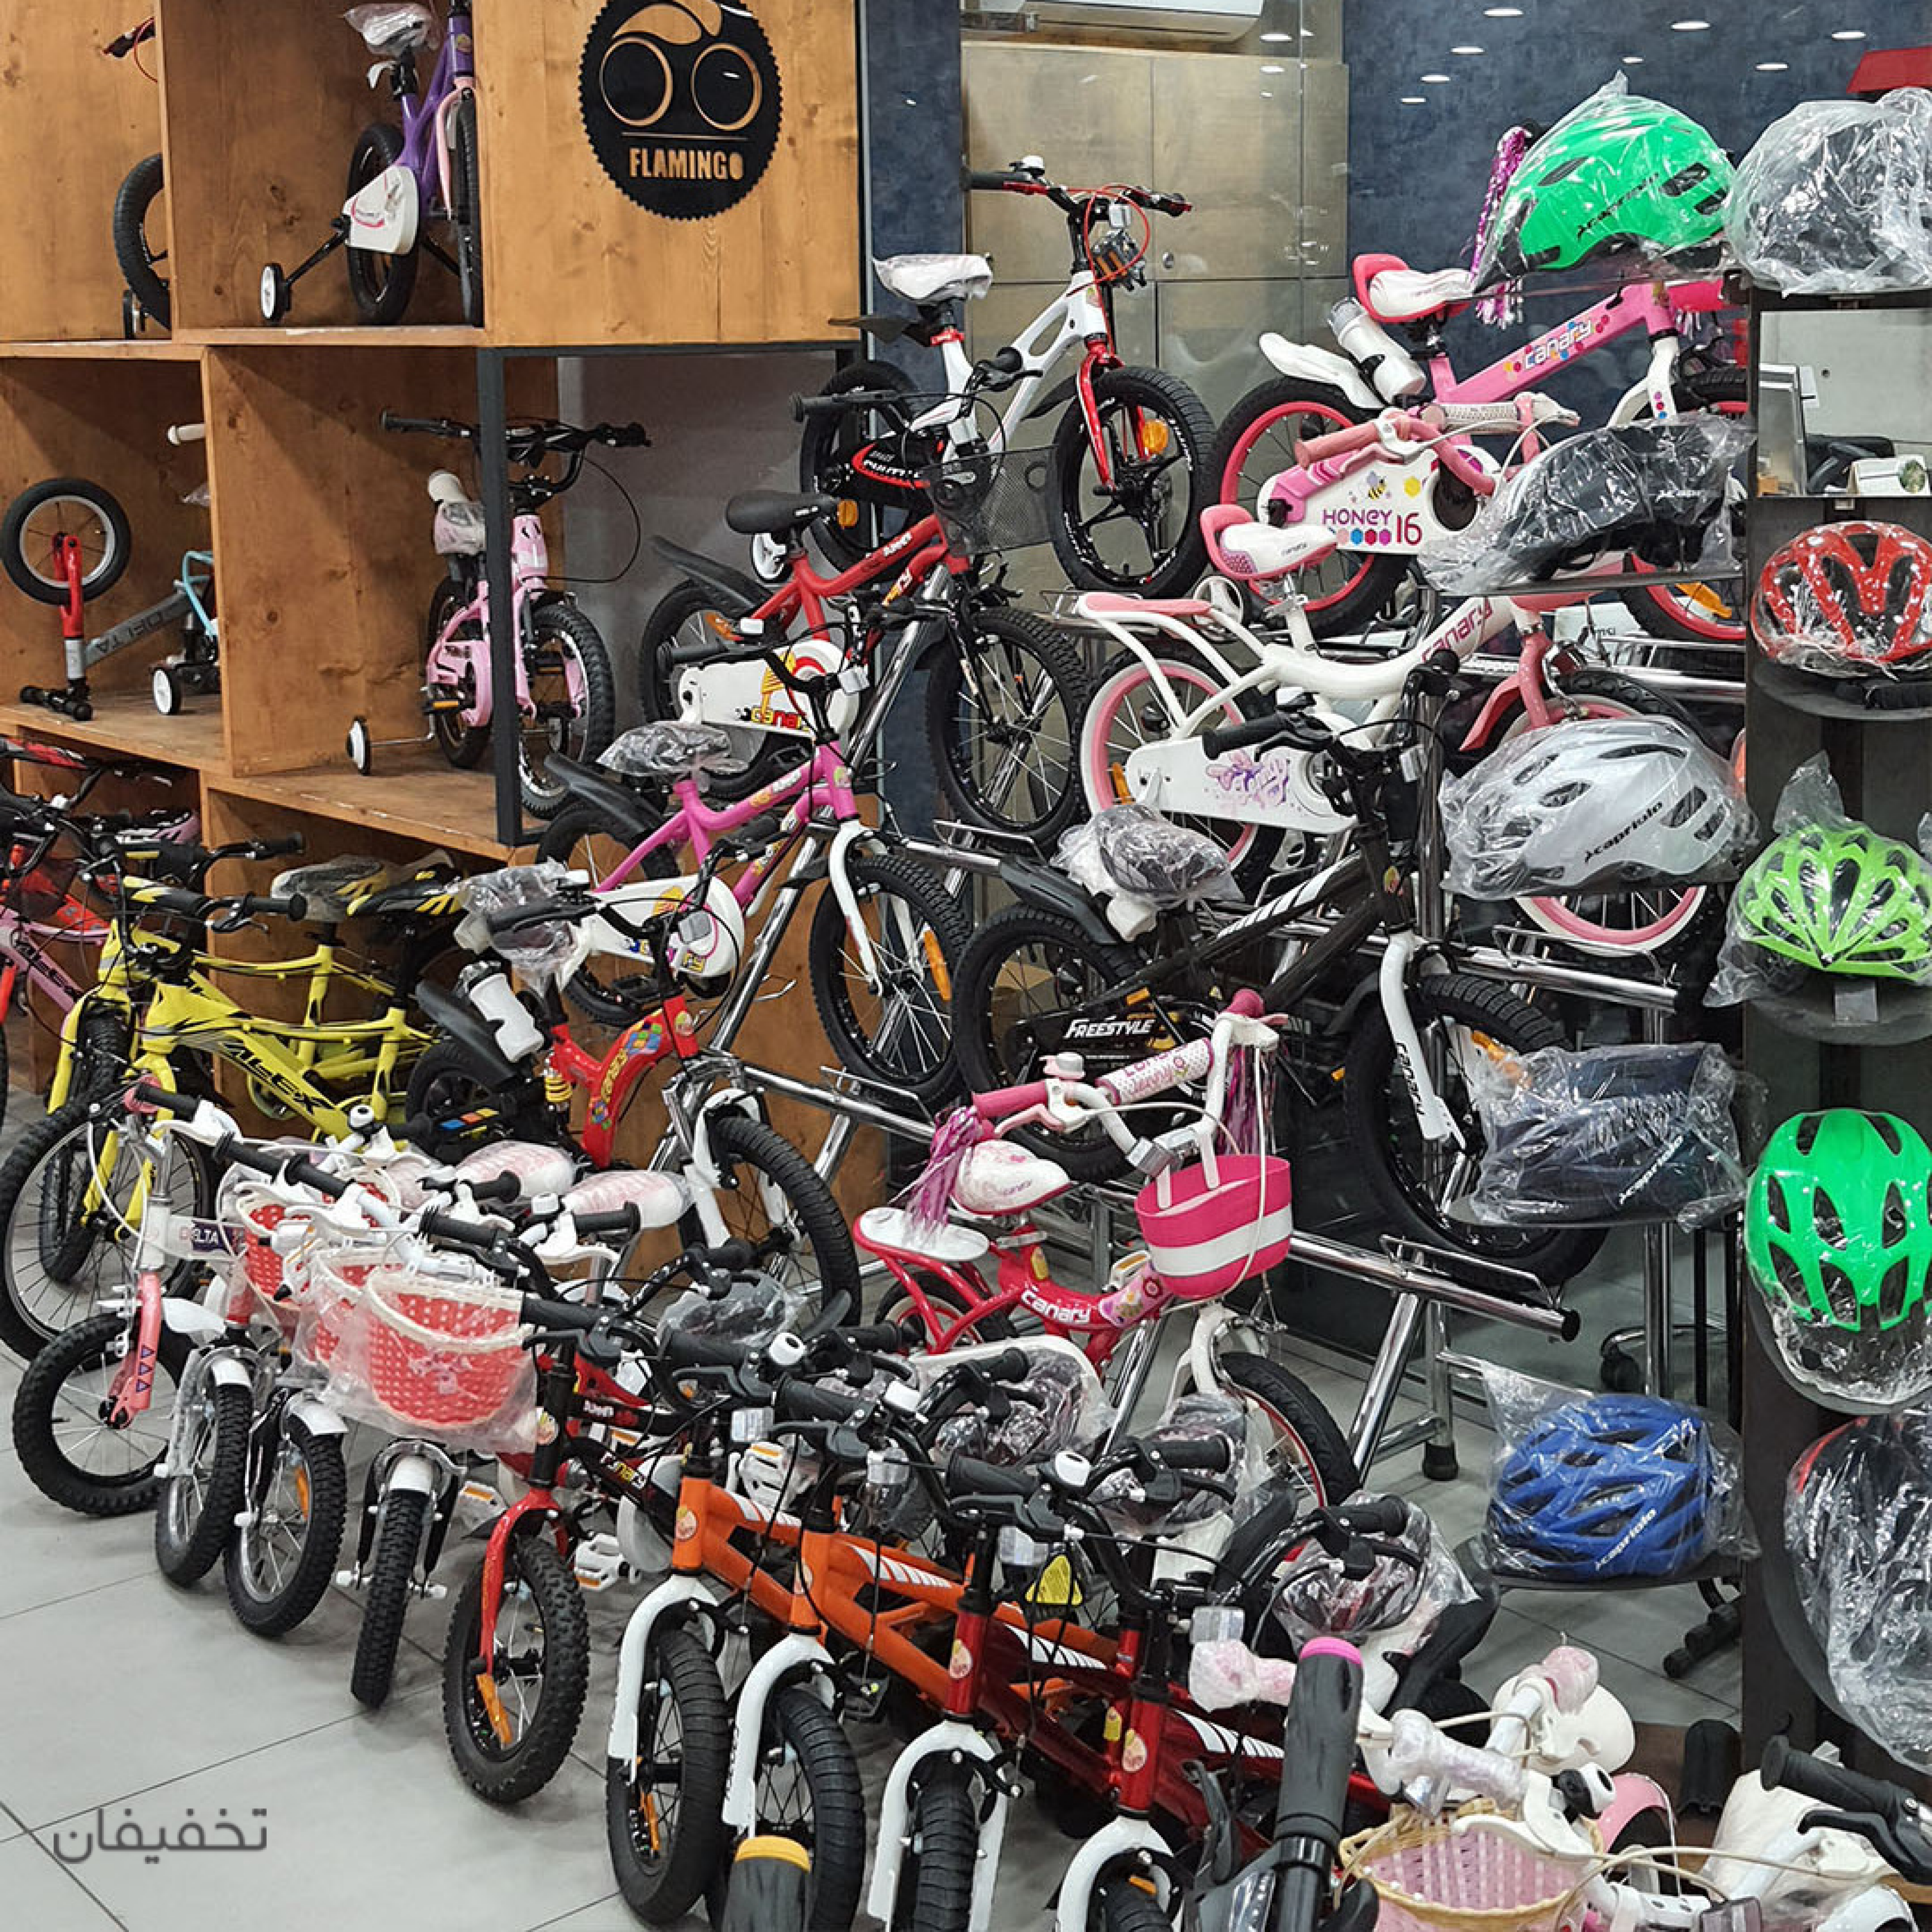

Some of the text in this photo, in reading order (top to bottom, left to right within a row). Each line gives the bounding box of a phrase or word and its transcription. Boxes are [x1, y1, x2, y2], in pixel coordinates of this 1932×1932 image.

[629, 148, 744, 180] FLAMINGO
[1397, 512, 1423, 545] 16
[1063, 1019, 1157, 1040] FREESTYLE
